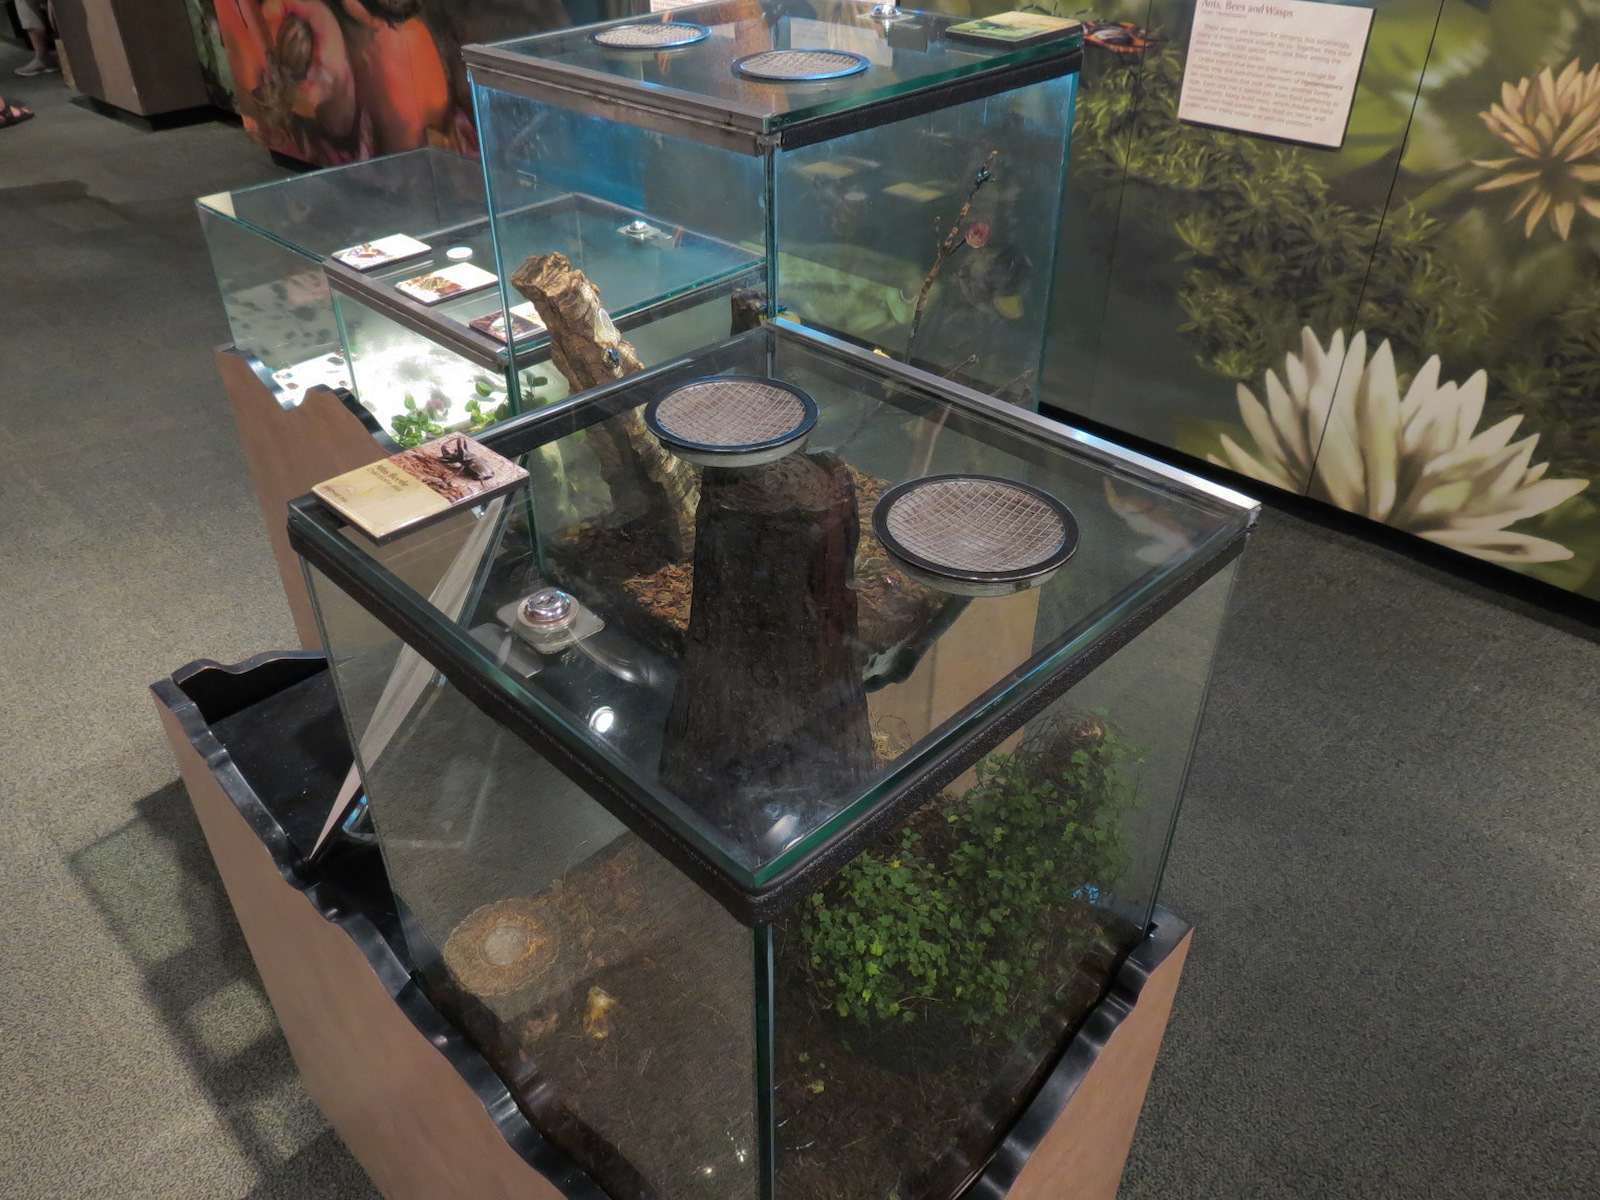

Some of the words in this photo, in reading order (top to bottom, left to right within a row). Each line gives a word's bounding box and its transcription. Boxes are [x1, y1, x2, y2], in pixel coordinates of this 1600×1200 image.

[1201, 0, 1222, 10] Ants,
[1225, 1, 1246, 11] Bees
[1247, 3, 1265, 14] and
[1263, 5, 1294, 19] Wasps
